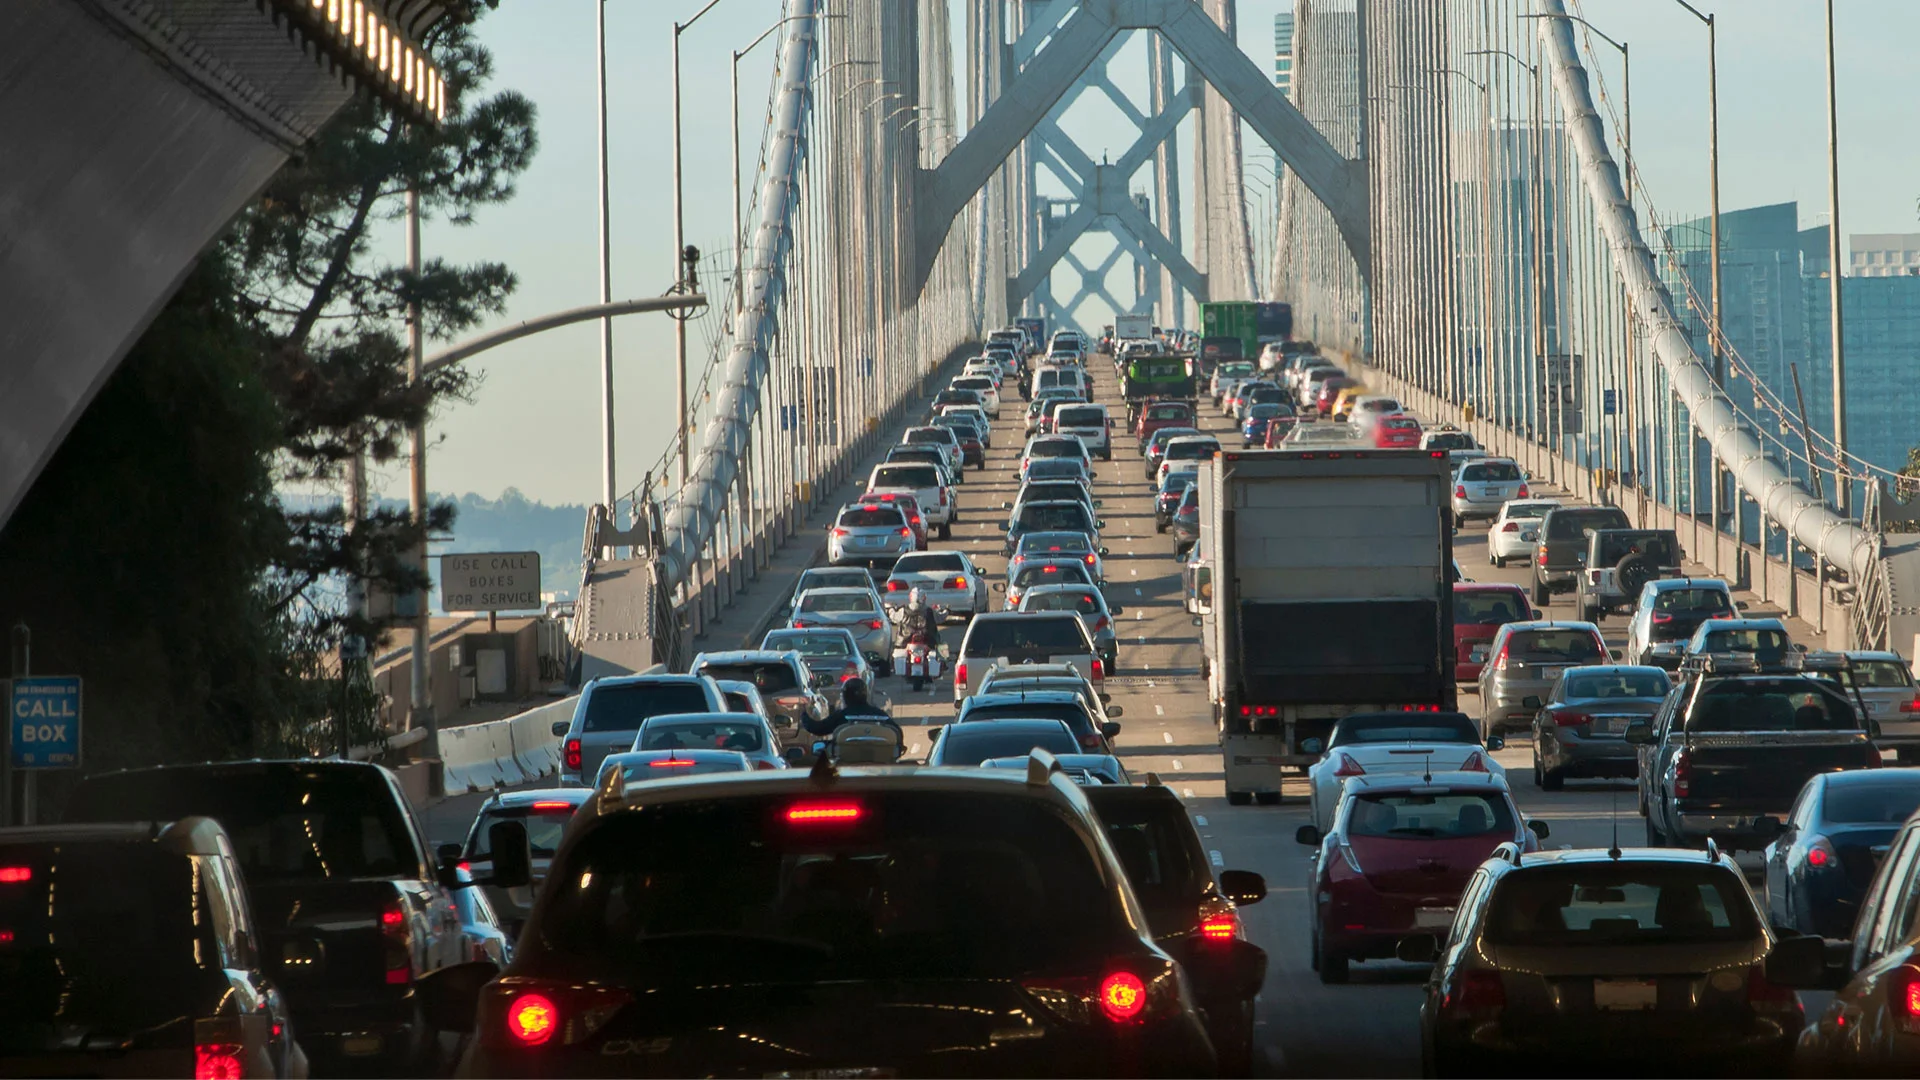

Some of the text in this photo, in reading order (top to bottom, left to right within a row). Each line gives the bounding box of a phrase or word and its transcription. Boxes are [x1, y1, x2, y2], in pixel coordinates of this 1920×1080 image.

[452, 558, 528, 571] USE CALL
[469, 575, 514, 587] BOXES
[447, 591, 534, 605] FOR SERVICE
[15, 699, 76, 718] CALL
[22, 724, 67, 742] BOX
